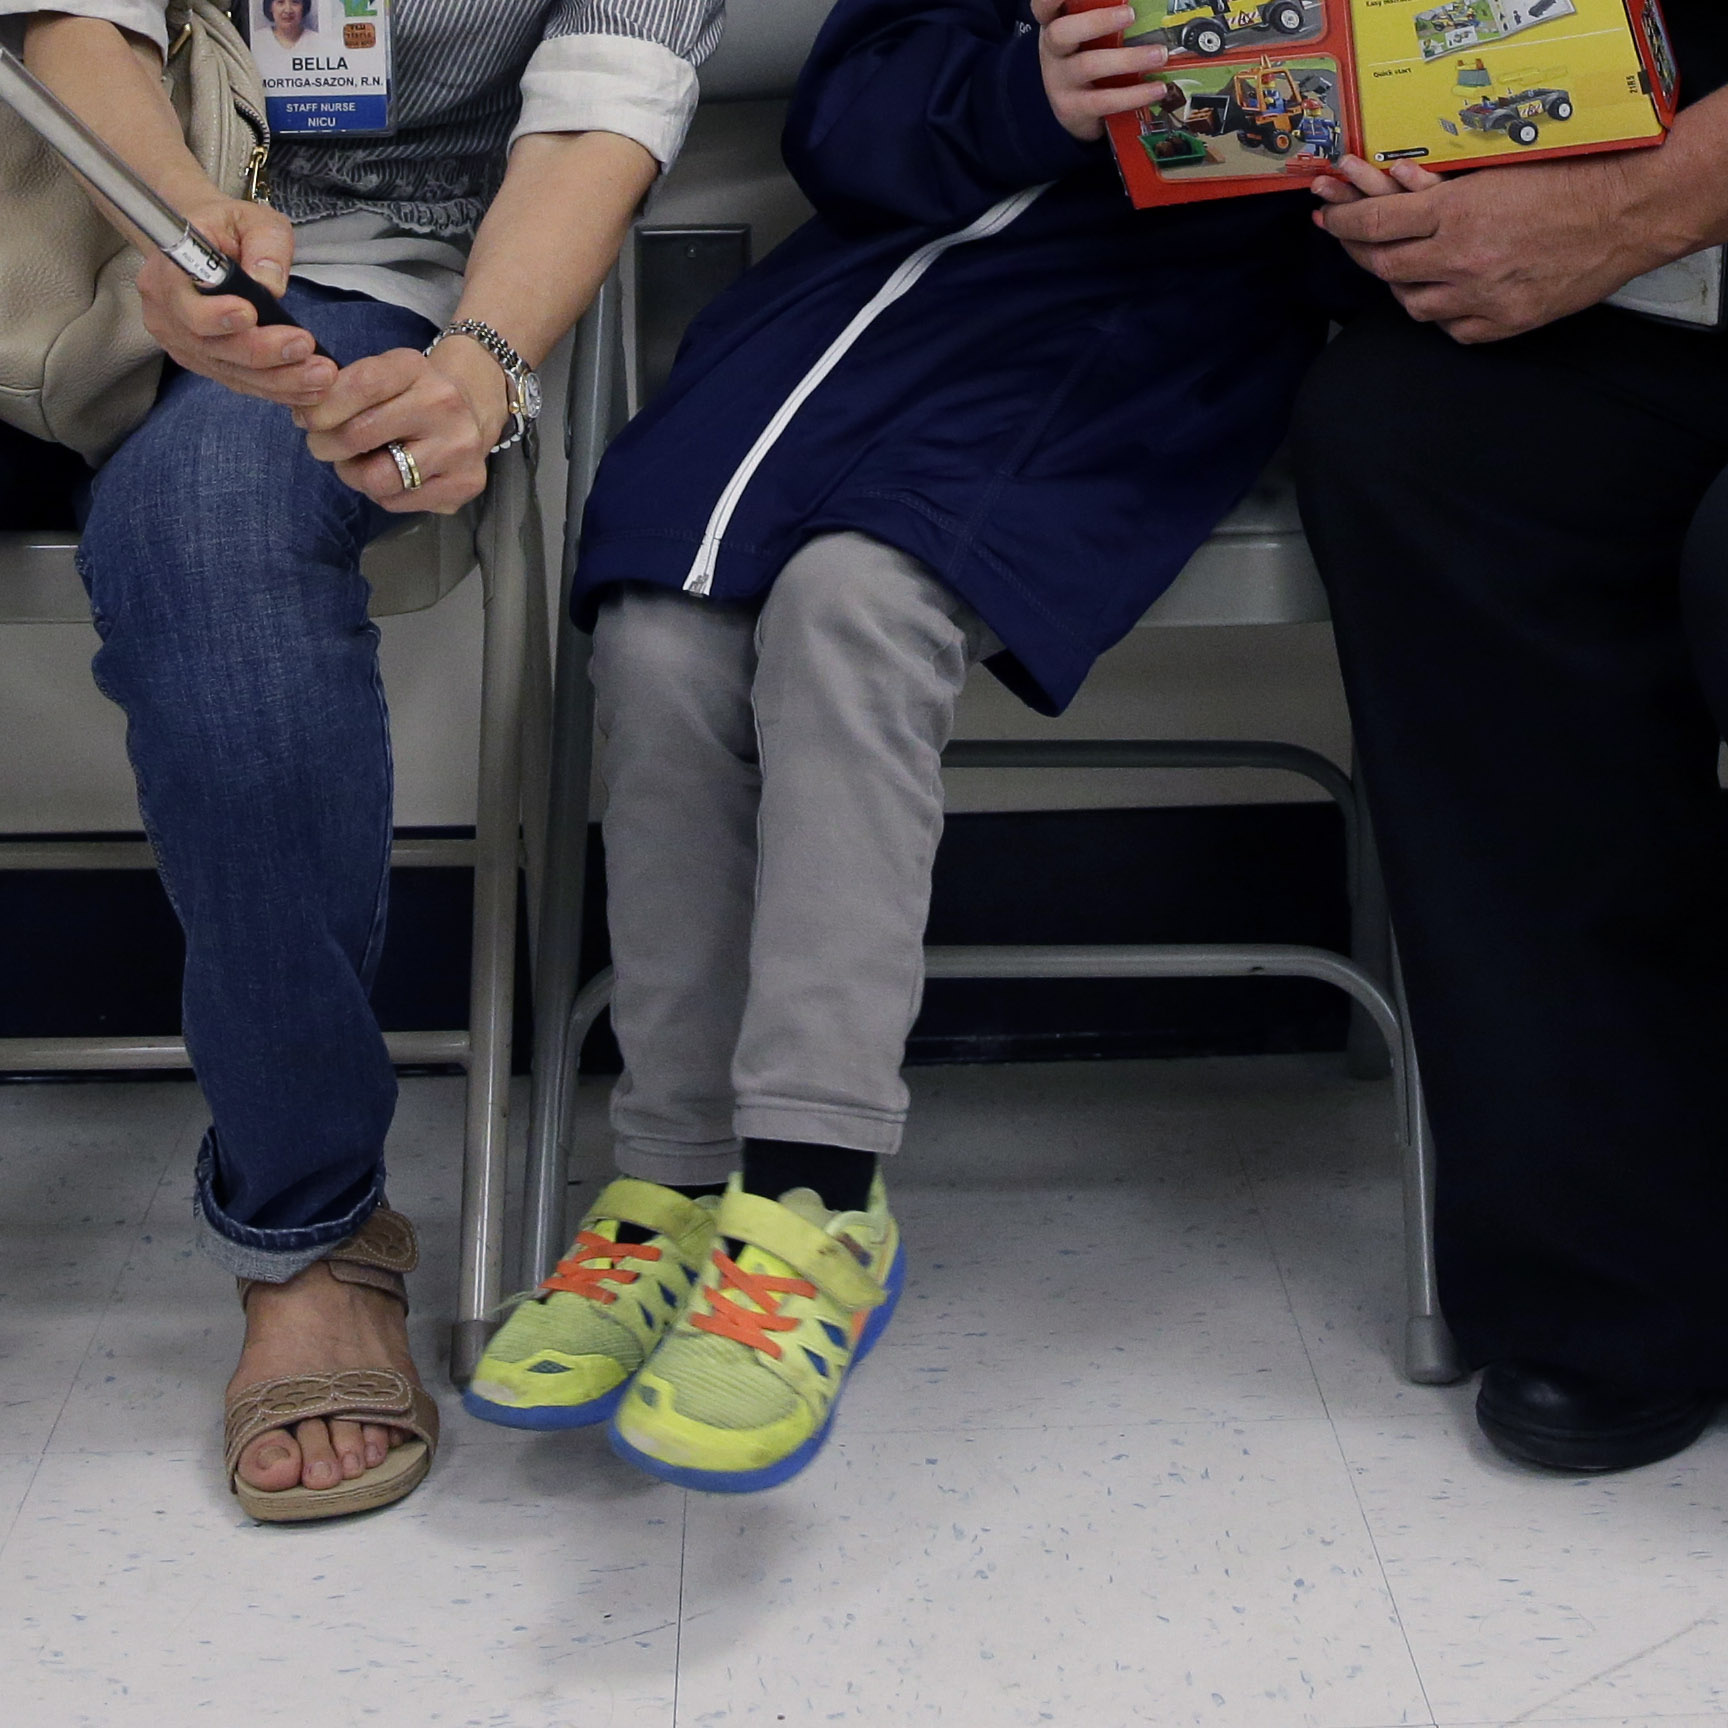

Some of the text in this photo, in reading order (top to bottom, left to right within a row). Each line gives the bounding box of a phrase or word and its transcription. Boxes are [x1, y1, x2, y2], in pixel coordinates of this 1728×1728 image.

[292, 57, 348, 71] BELLA
[1373, 69, 1392, 78] Quick
[360, 76, 384, 87] R.N.
[286, 102, 356, 113] STAFF NURSE
[307, 117, 336, 127] NICU
